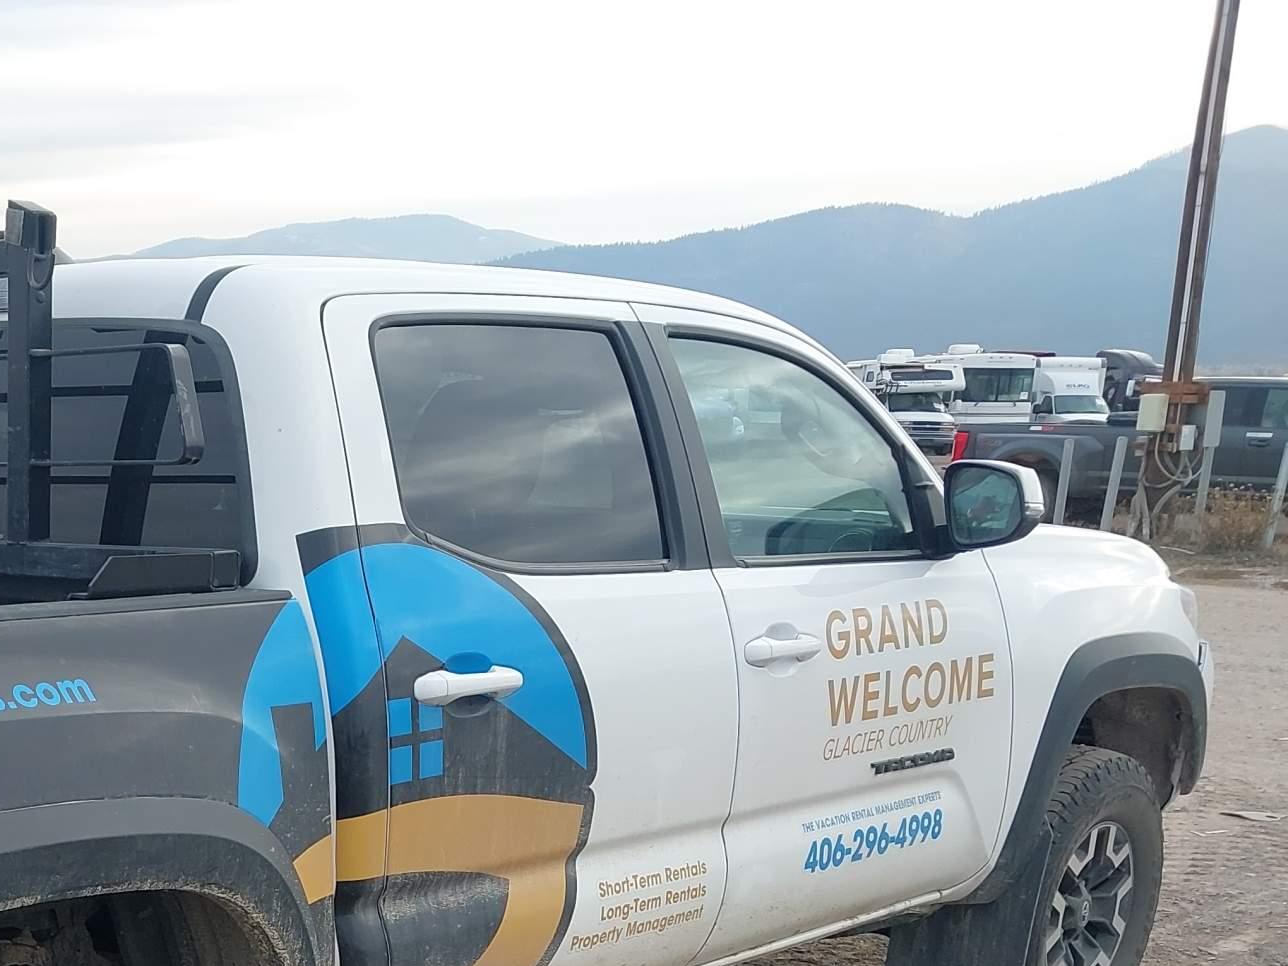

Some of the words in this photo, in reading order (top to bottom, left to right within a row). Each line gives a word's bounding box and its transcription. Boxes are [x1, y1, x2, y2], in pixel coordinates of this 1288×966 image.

[825, 598, 948, 660] GRAND
[827, 653, 995, 727] WELCOME
[823, 728, 885, 761] GLACIER
[889, 714, 954, 746] COUNTRY
[870, 747, 955, 777] TACOMA
[802, 823, 815, 833] THE
[815, 813, 851, 830] VACATION
[851, 807, 874, 822] RENTAL
[875, 796, 917, 816] MANAGEMENT
[918, 790, 942, 805] EXPERTS
[804, 808, 943, 873] 406-296-4998
[597, 869, 662, 899] Short-Term
[665, 860, 707, 887] Rentals
[600, 894, 661, 923] Long-Term
[665, 882, 707, 908] Rentals
[570, 921, 623, 953] Property
[626, 904, 704, 938] Management
